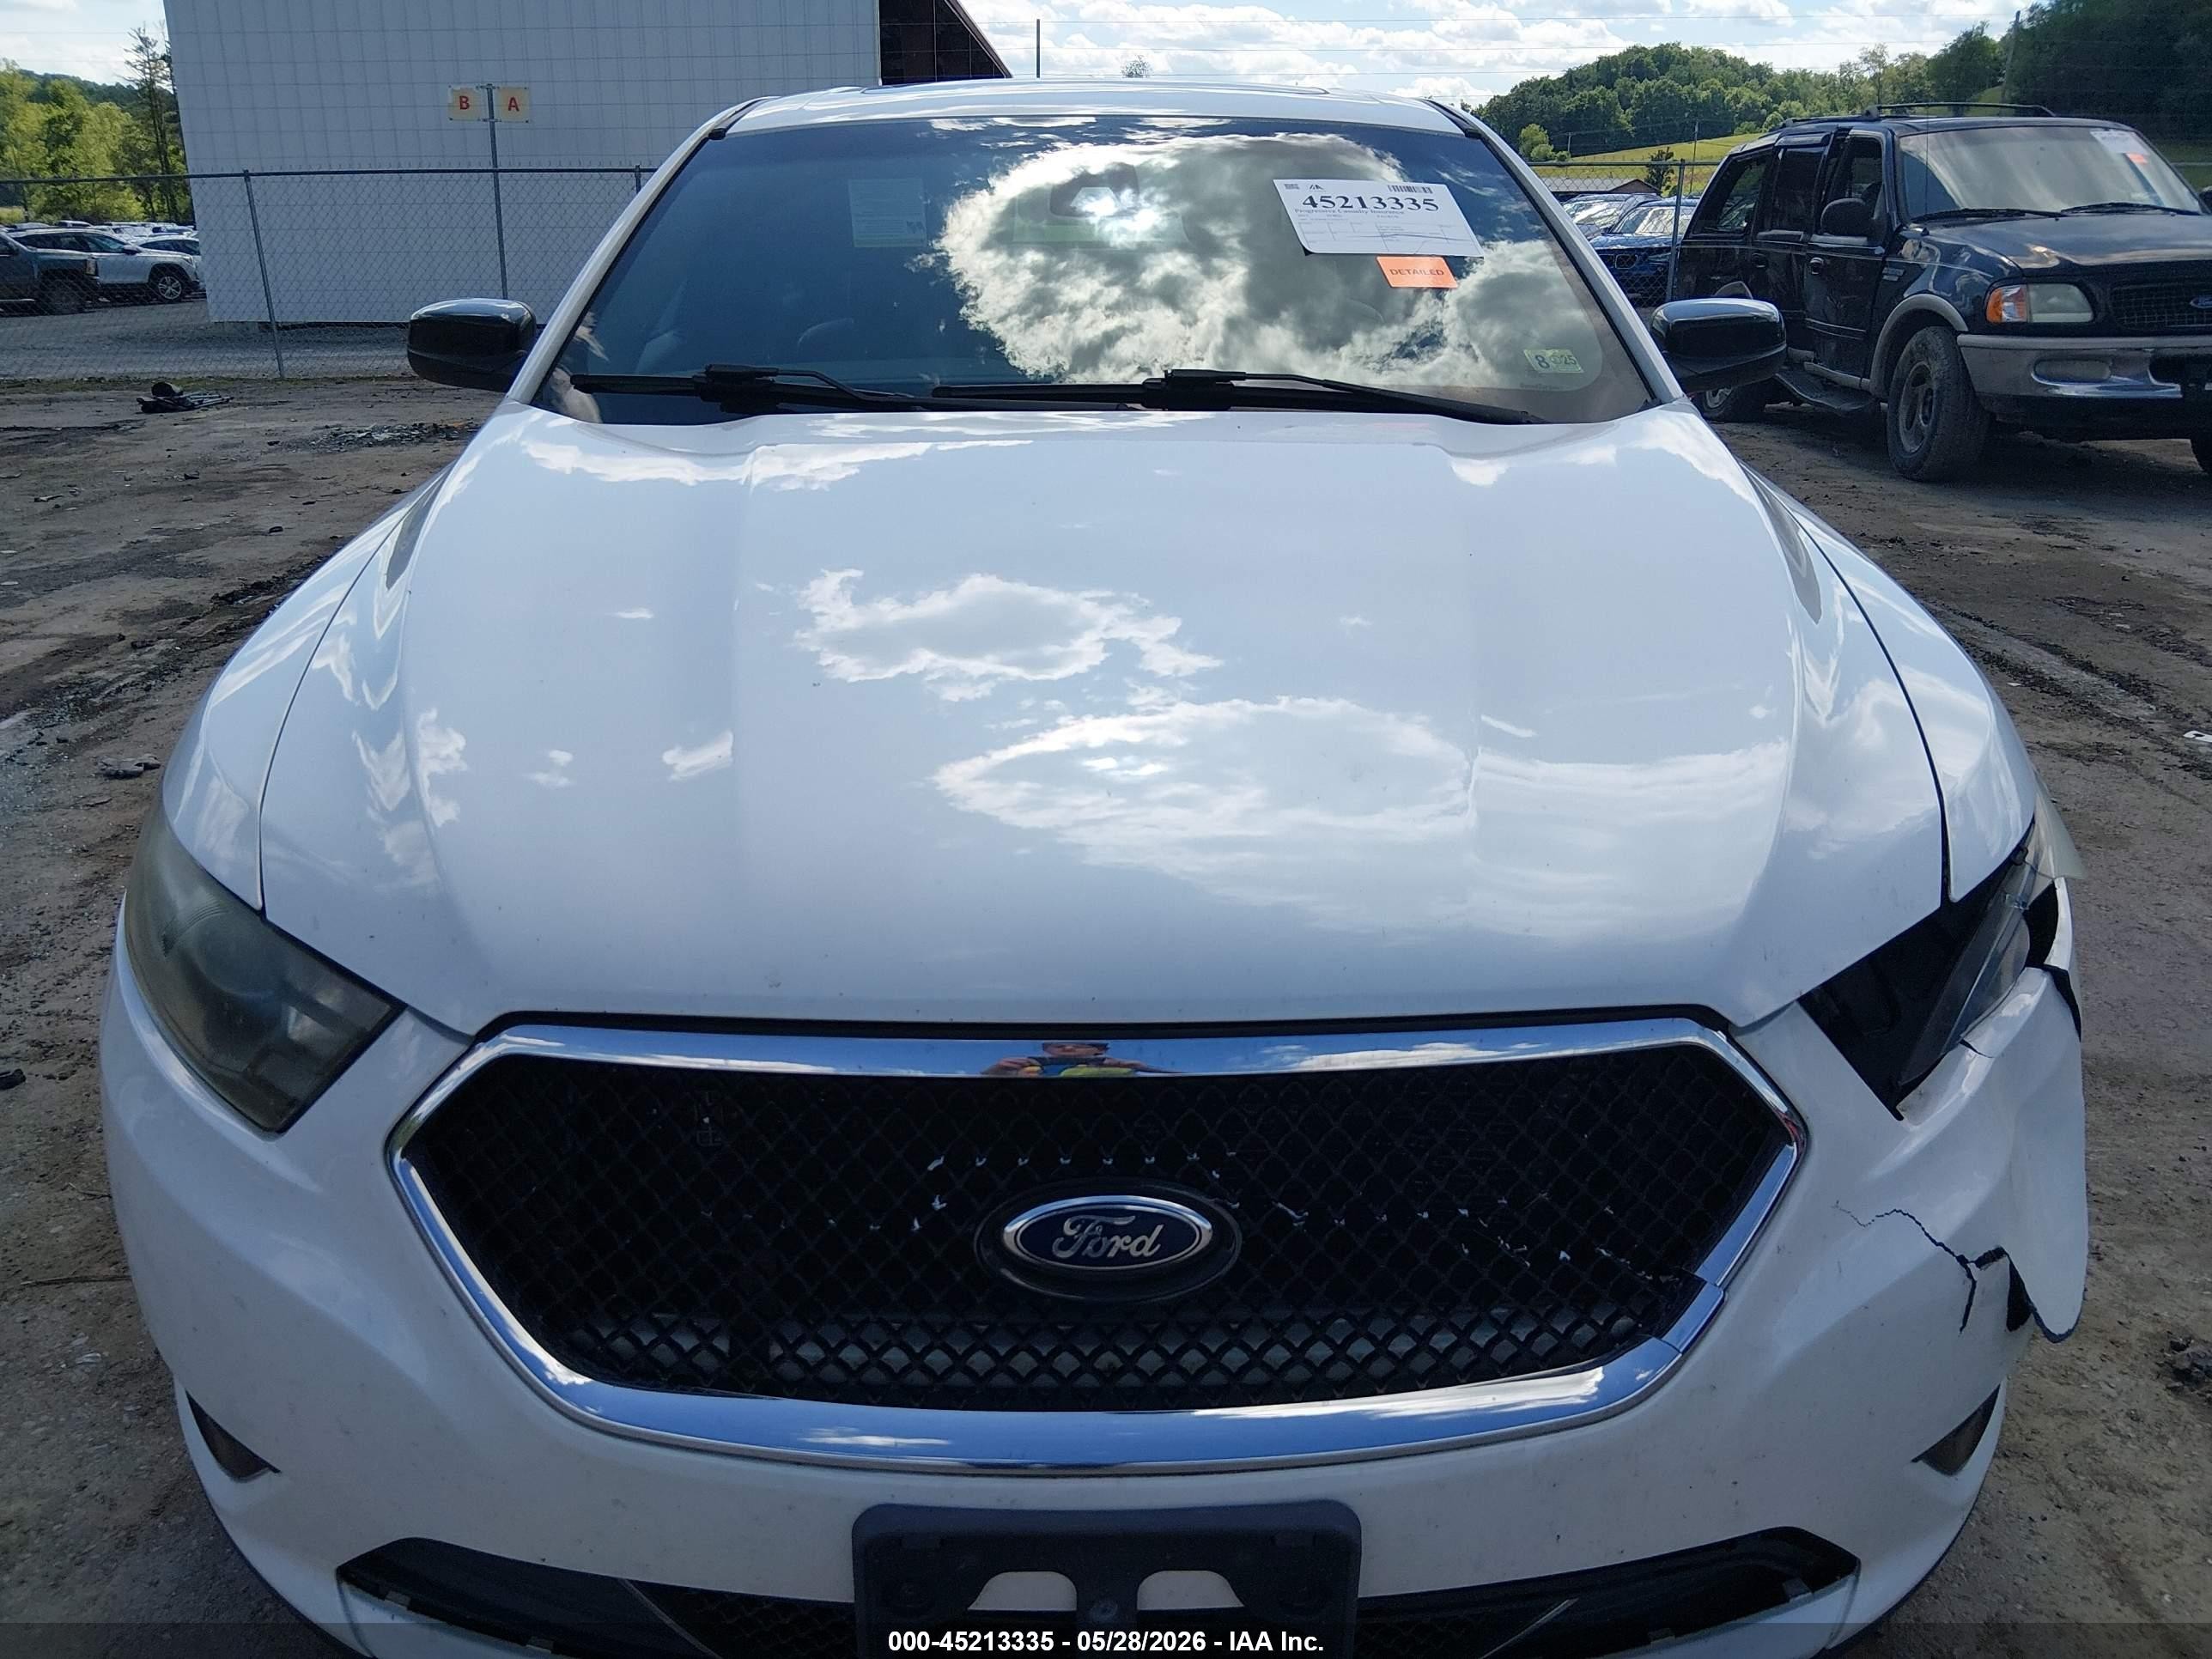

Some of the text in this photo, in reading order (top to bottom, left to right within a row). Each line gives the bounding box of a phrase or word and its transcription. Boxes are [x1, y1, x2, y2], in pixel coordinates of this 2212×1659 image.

[459, 95, 471, 110] B
[507, 96, 520, 112] A
[1302, 194, 1440, 212] 45213335
[1535, 355, 1577, 368] 8 25
[1052, 1214, 1164, 1259] Ford
